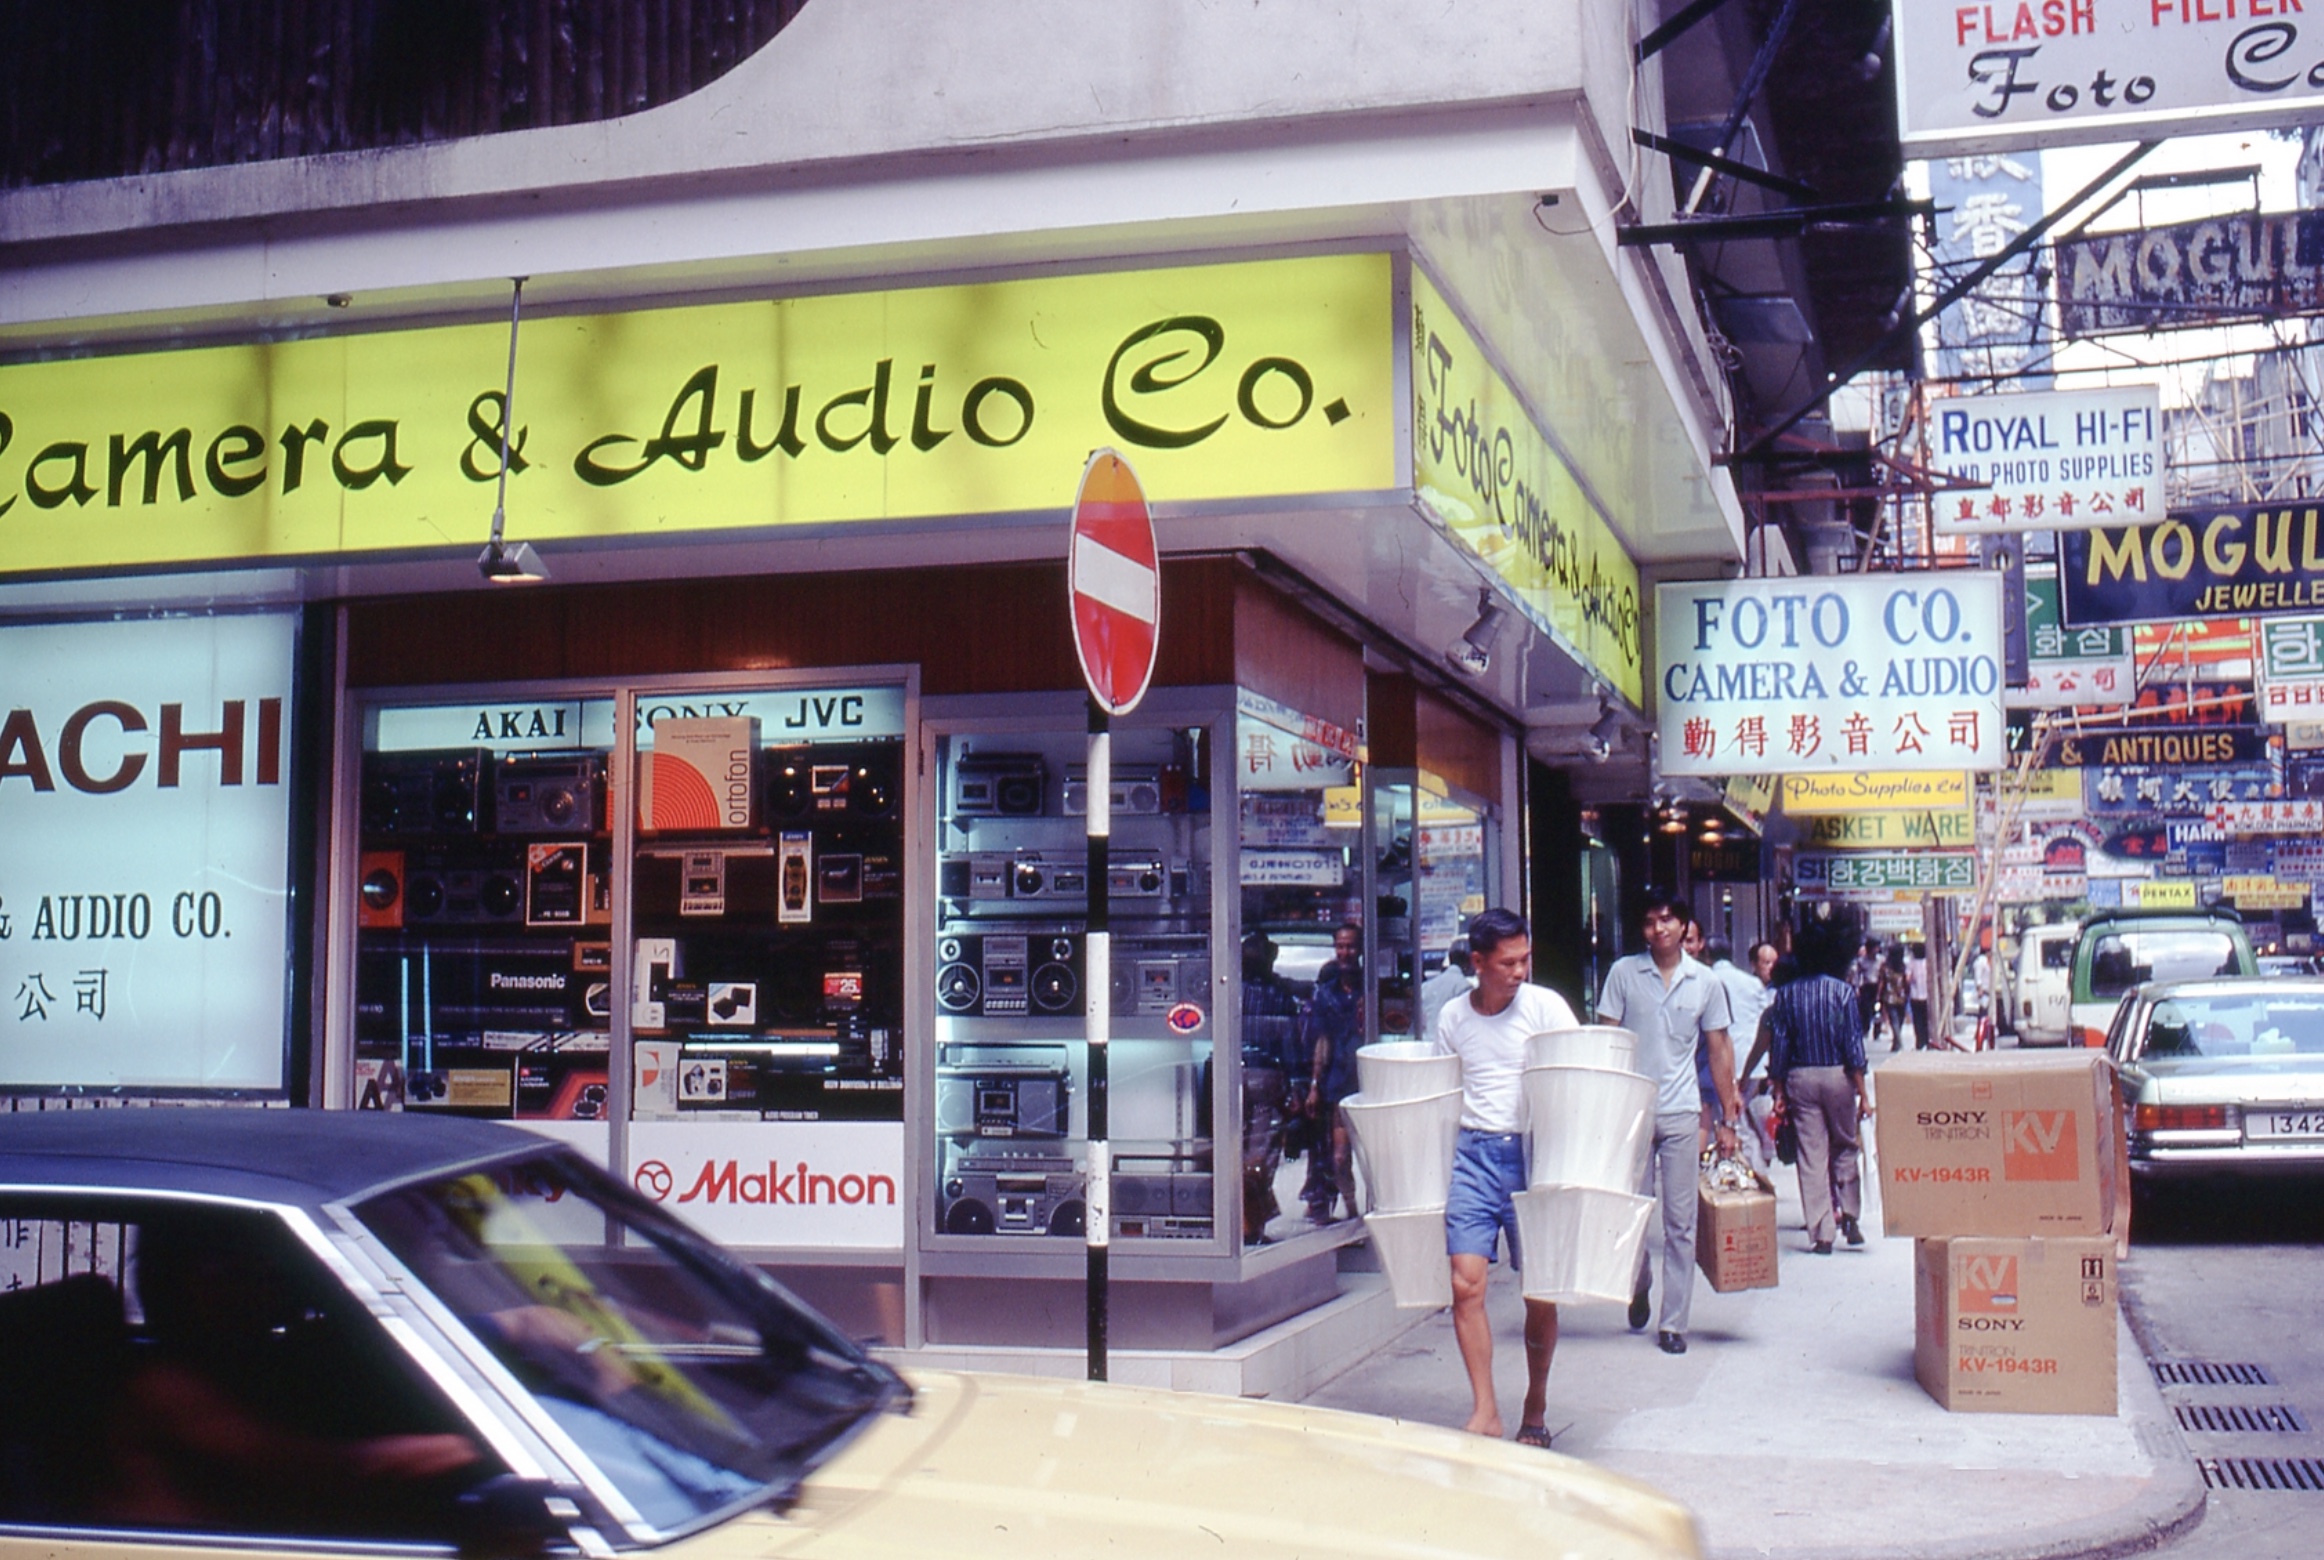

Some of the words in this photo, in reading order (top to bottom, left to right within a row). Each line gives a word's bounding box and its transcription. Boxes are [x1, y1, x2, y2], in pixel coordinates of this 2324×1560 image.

[1956, 0, 2095, 46] FLASH
[1968, 45, 2156, 118] Foto
[2072, 217, 2315, 298] MOGUL
[459, 389, 531, 485] &
[573, 358, 1035, 486] Audio
[1101, 315, 1353, 450] Co.
[1942, 409, 2059, 455] ROYAL
[2075, 407, 2153, 447] HI-FI
[1427, 330, 1493, 505] Foto
[1492, 426, 1570, 591] Camera
[1991, 459, 2050, 485] PHOTO
[2060, 452, 2153, 481] SUPPLIES
[2087, 509, 2324, 586] MOGUL
[1692, 592, 1850, 650] FOTO
[1883, 588, 1972, 646] CO.
[1664, 659, 1829, 702] CAMERA
[1838, 659, 1869, 698] &
[1880, 654, 1998, 698] AUDIO
[471, 708, 567, 740] AKAI
[785, 695, 863, 729] JVC
[1682, 709, 1981, 760] 勤得影音公司
[2102, 732, 2236, 765] ANTIQUES
[724, 749, 748, 826] ortofon
[1785, 777, 1847, 800] Photo
[1849, 771, 1932, 799] Supplies
[1902, 813, 1969, 839] WARE
[1831, 856, 1974, 886] 한강백화점
[2142, 888, 2192, 900] PENTAX
[31, 891, 151, 941] AUDIO
[172, 890, 232, 939] CO.
[14, 967, 109, 1023] 公司
[490, 973, 566, 989] Panasonic
[1917, 1110, 1987, 1126] SONY
[1924, 1125, 1990, 1140] TRINITRON
[2005, 1112, 2066, 1155] KV
[677, 1159, 895, 1205] Makinon
[1894, 1167, 1990, 1183] KV-1943R
[1959, 1255, 2009, 1291] KV
[1957, 1317, 2024, 1331] SONY
[1959, 1345, 2016, 1357] TRINITRON
[1959, 1358, 2057, 1375] KV-1943R
